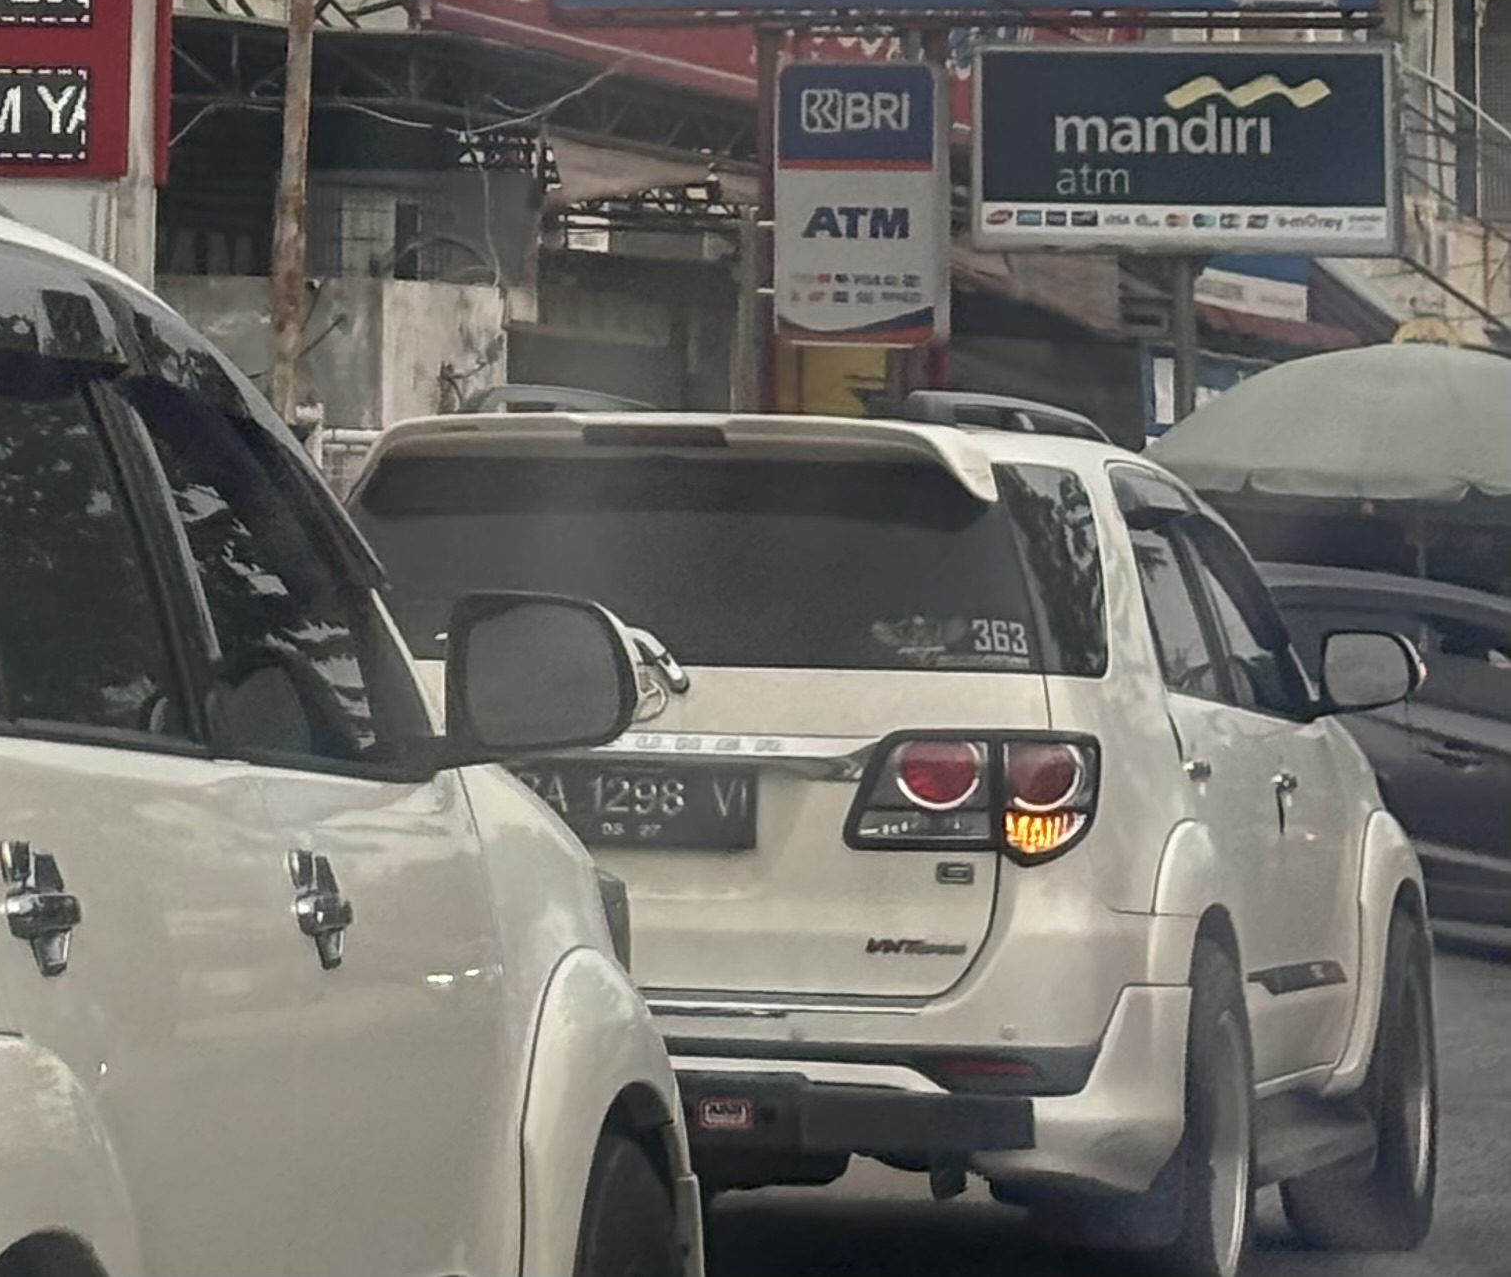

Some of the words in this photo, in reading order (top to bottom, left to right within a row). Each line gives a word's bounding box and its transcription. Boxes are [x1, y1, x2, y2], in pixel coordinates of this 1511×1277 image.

[845, 92, 910, 131] BRI
[1054, 104, 1272, 154] mandiri
[1055, 162, 1131, 195] atm
[802, 206, 911, 239] ATM
[971, 618, 1028, 655] 363
[589, 775, 685, 816] 1298
